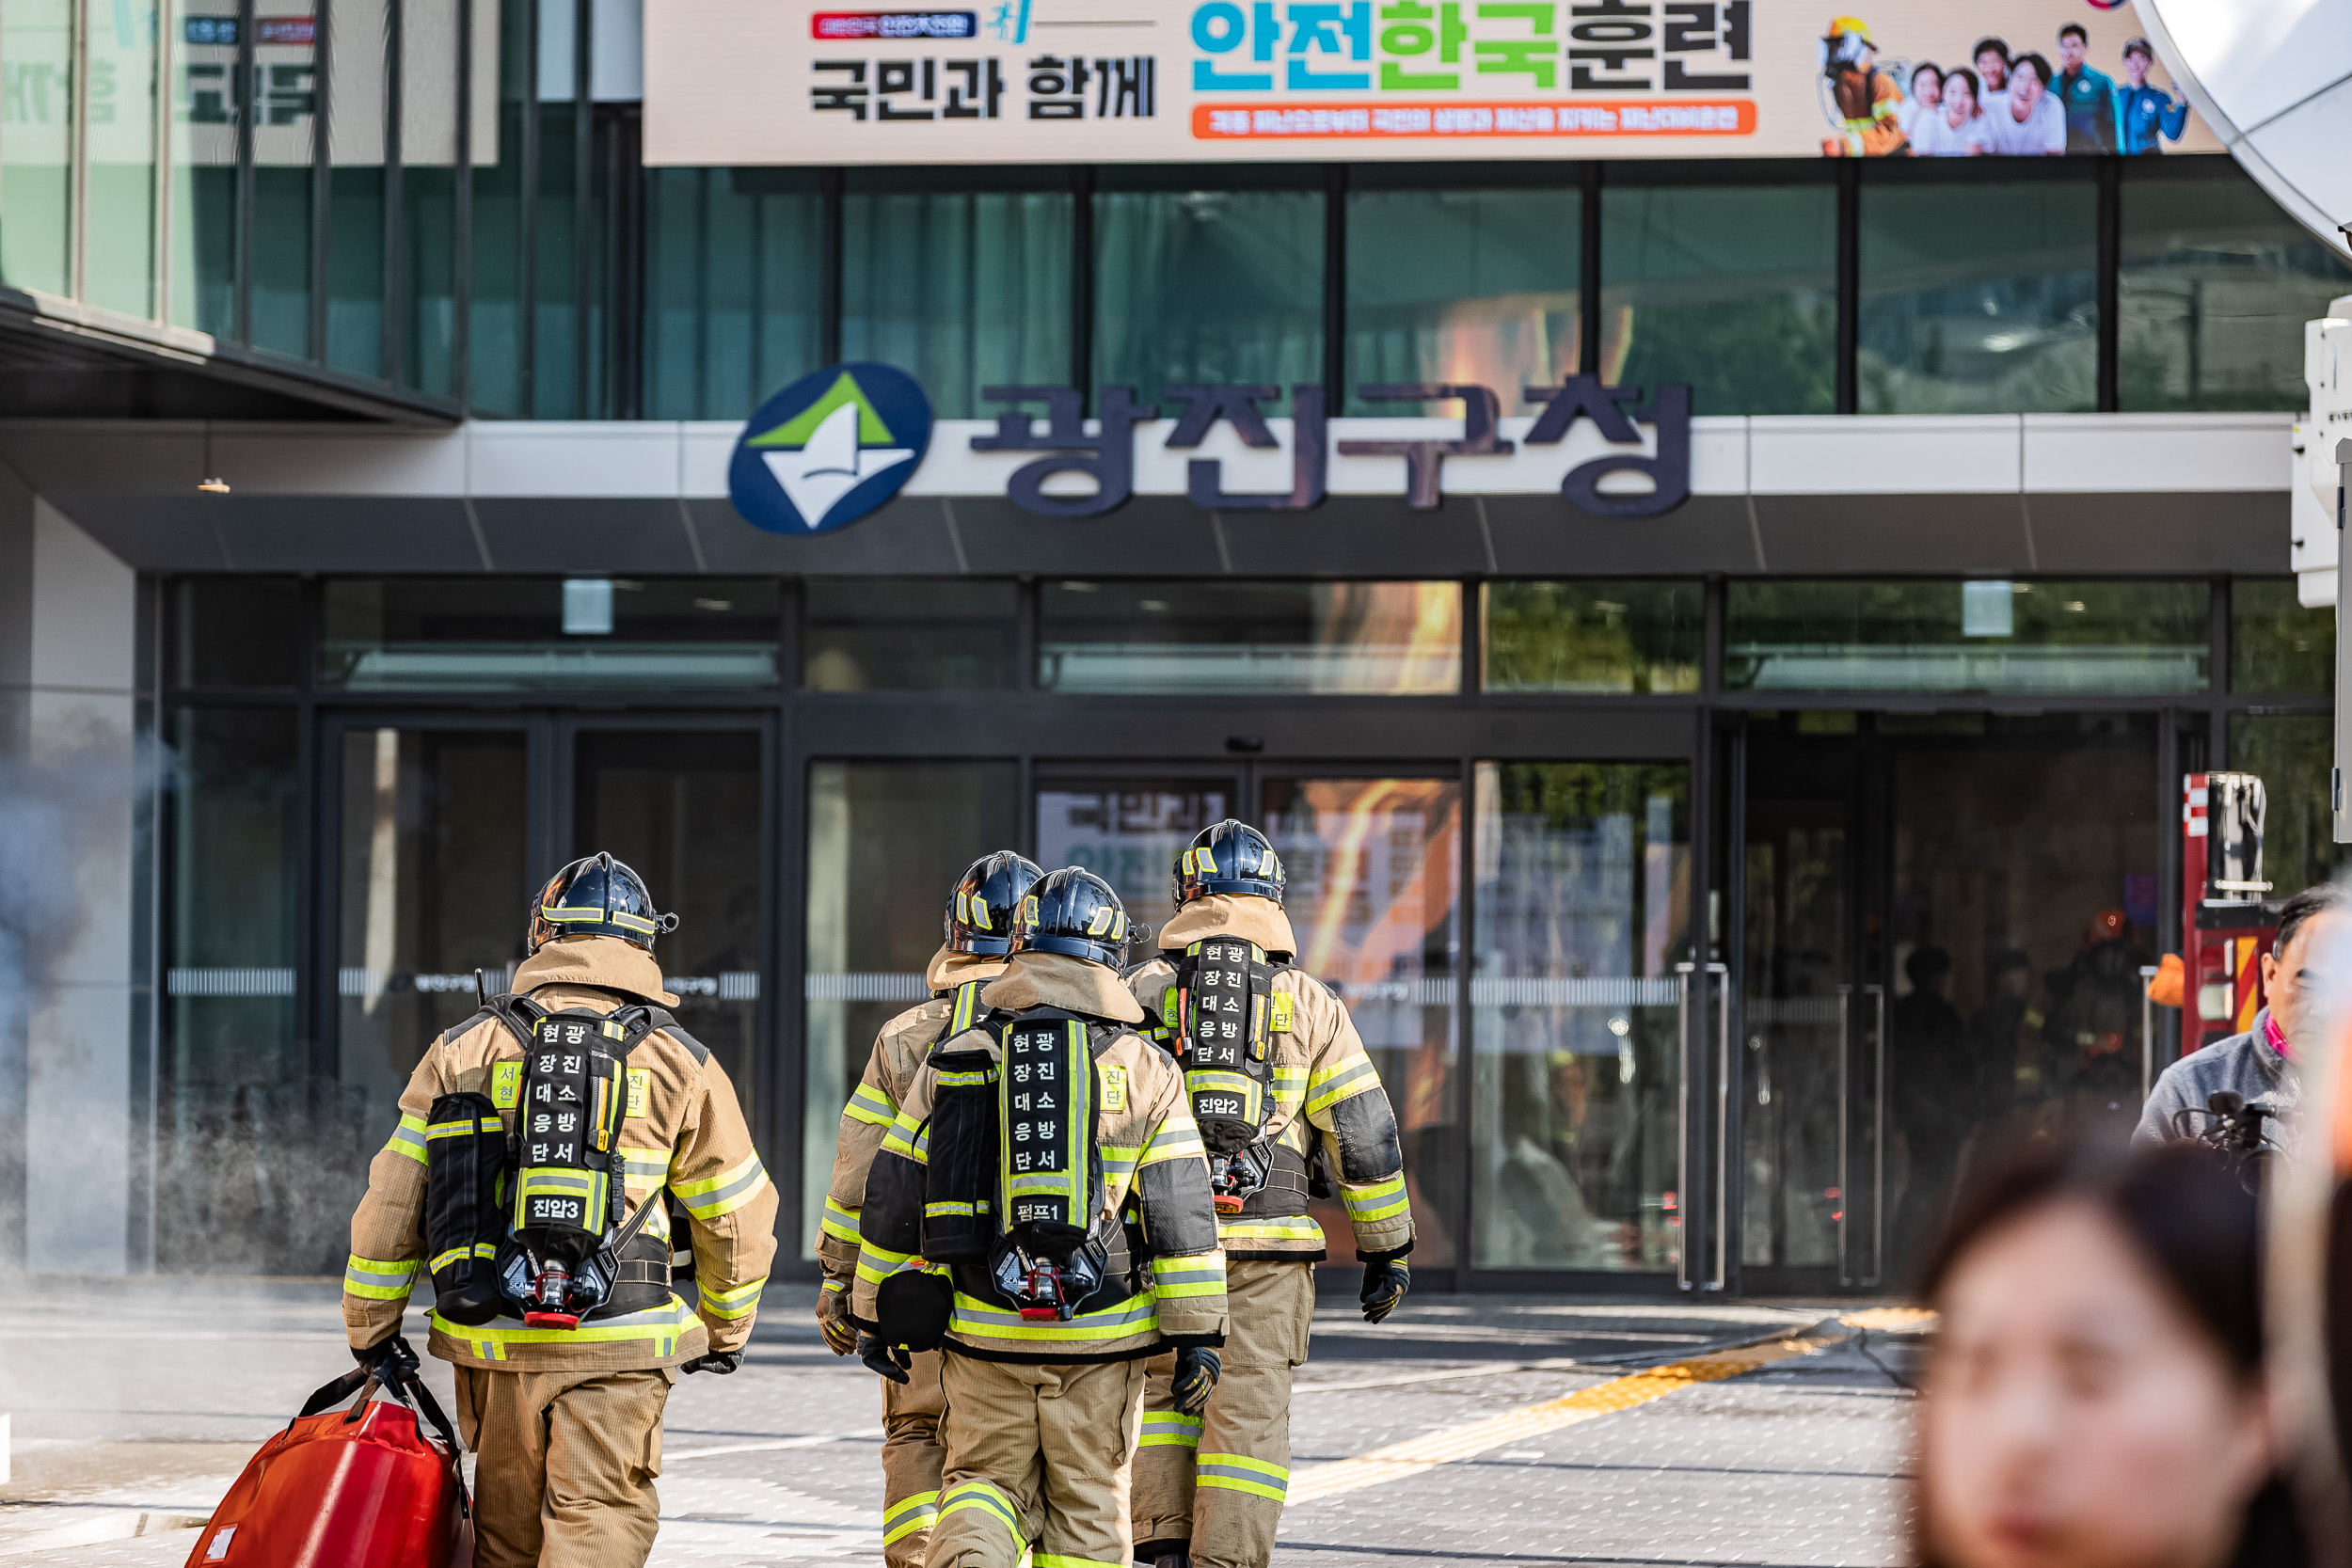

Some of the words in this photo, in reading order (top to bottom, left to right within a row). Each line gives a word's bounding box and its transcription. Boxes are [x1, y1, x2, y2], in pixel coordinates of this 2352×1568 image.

[812, 58, 1005, 121] 국민과
[1029, 55, 1155, 120] 함께
[1190, 0, 1753, 91] 안전한국훈련
[970, 375, 1692, 518] 광진구청
[1198, 945, 1223, 1063] 현장대응단
[1218, 947, 1244, 1064] 광진소방서
[532, 1023, 560, 1163] 현장대응단
[554, 1024, 585, 1166] 광진소방서
[1013, 1035, 1032, 1171] 현장대응단
[1036, 1033, 1056, 1169] 광진소방서
[1199, 1098, 1239, 1116] 진압2
[532, 1198, 580, 1220] 진압3
[1017, 1203, 1058, 1222] 펌프1
